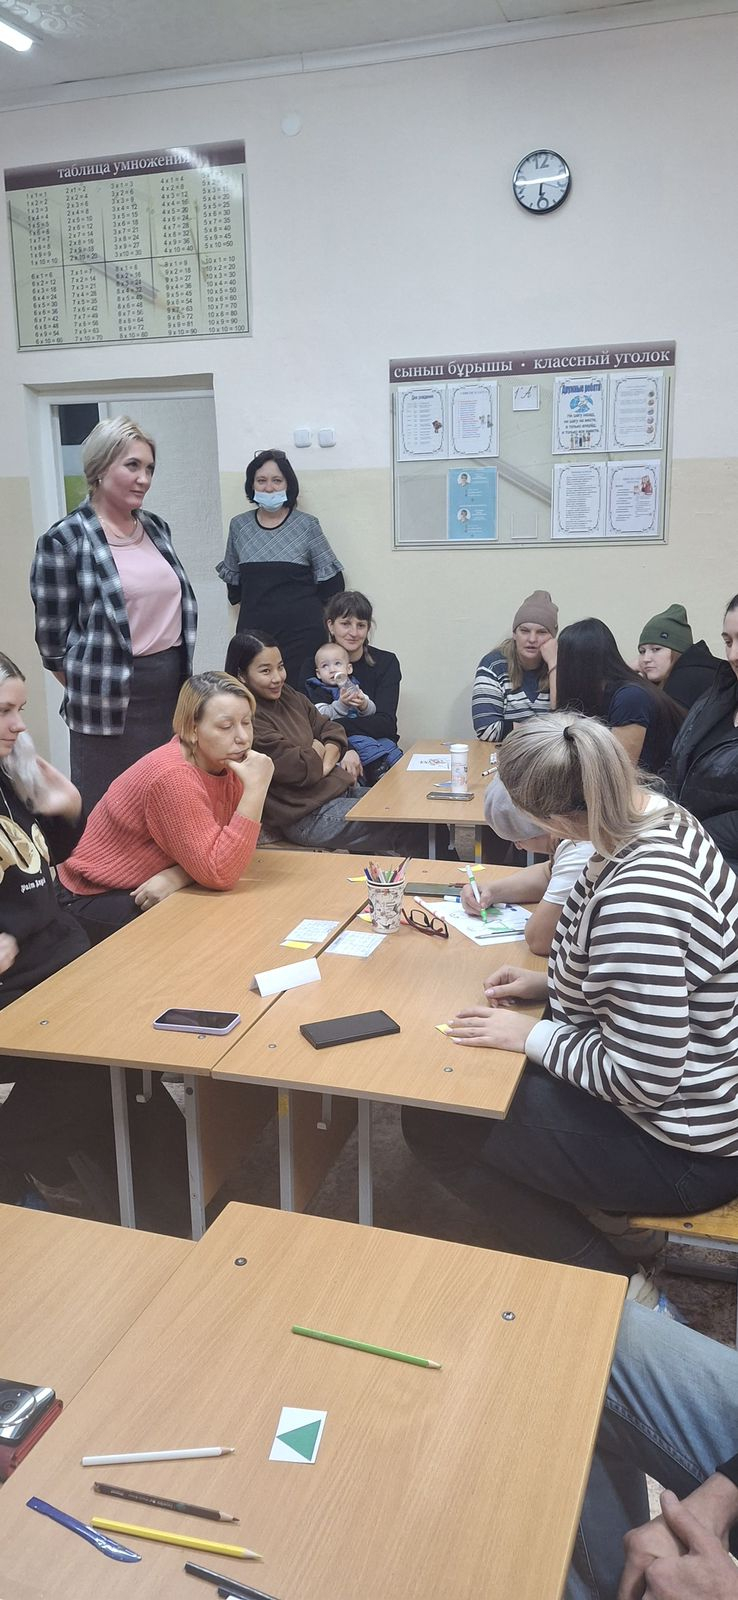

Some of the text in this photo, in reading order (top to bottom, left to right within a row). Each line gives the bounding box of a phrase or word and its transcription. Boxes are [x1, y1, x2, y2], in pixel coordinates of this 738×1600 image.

[533, 154, 549, 169] 12
[57, 163, 111, 179] таблица
[394, 350, 670, 378] сынып бұрышы классный уголок
